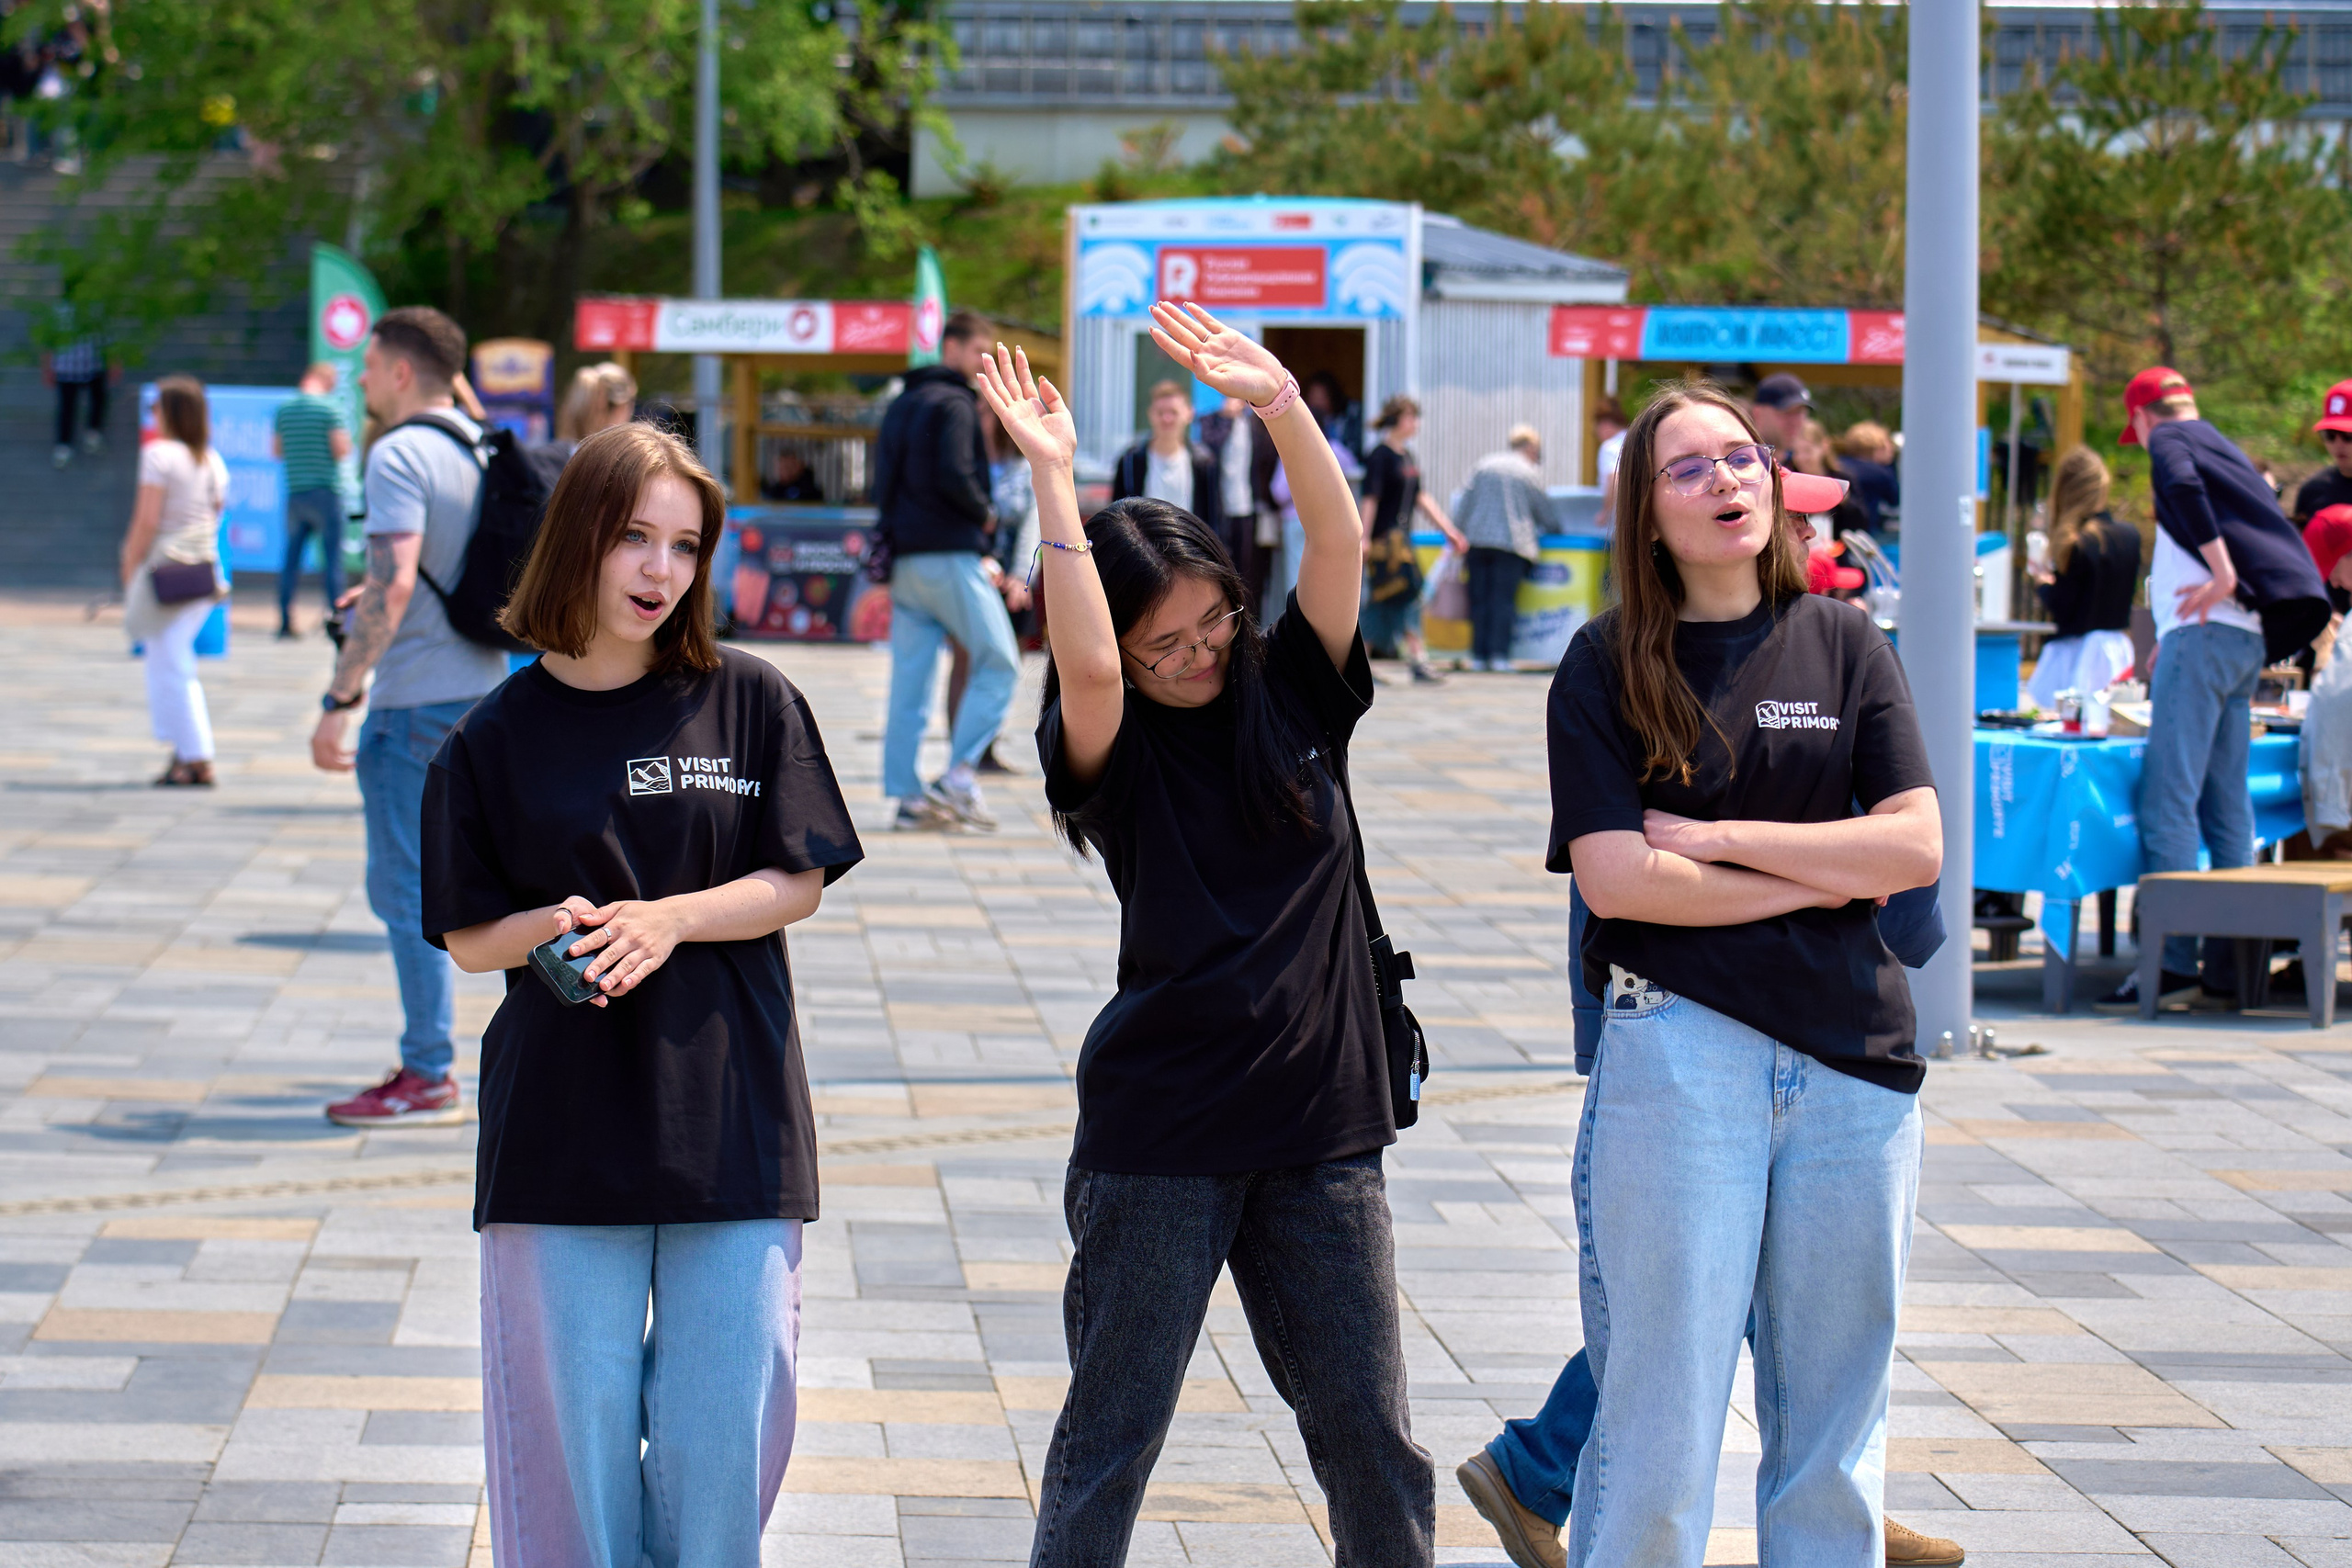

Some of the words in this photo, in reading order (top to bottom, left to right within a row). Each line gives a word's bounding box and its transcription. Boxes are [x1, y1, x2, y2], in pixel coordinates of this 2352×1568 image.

[1779, 702, 1818, 716] VISIT
[1781, 716, 1841, 731] PRIMOR
[677, 756, 731, 773] VISIT
